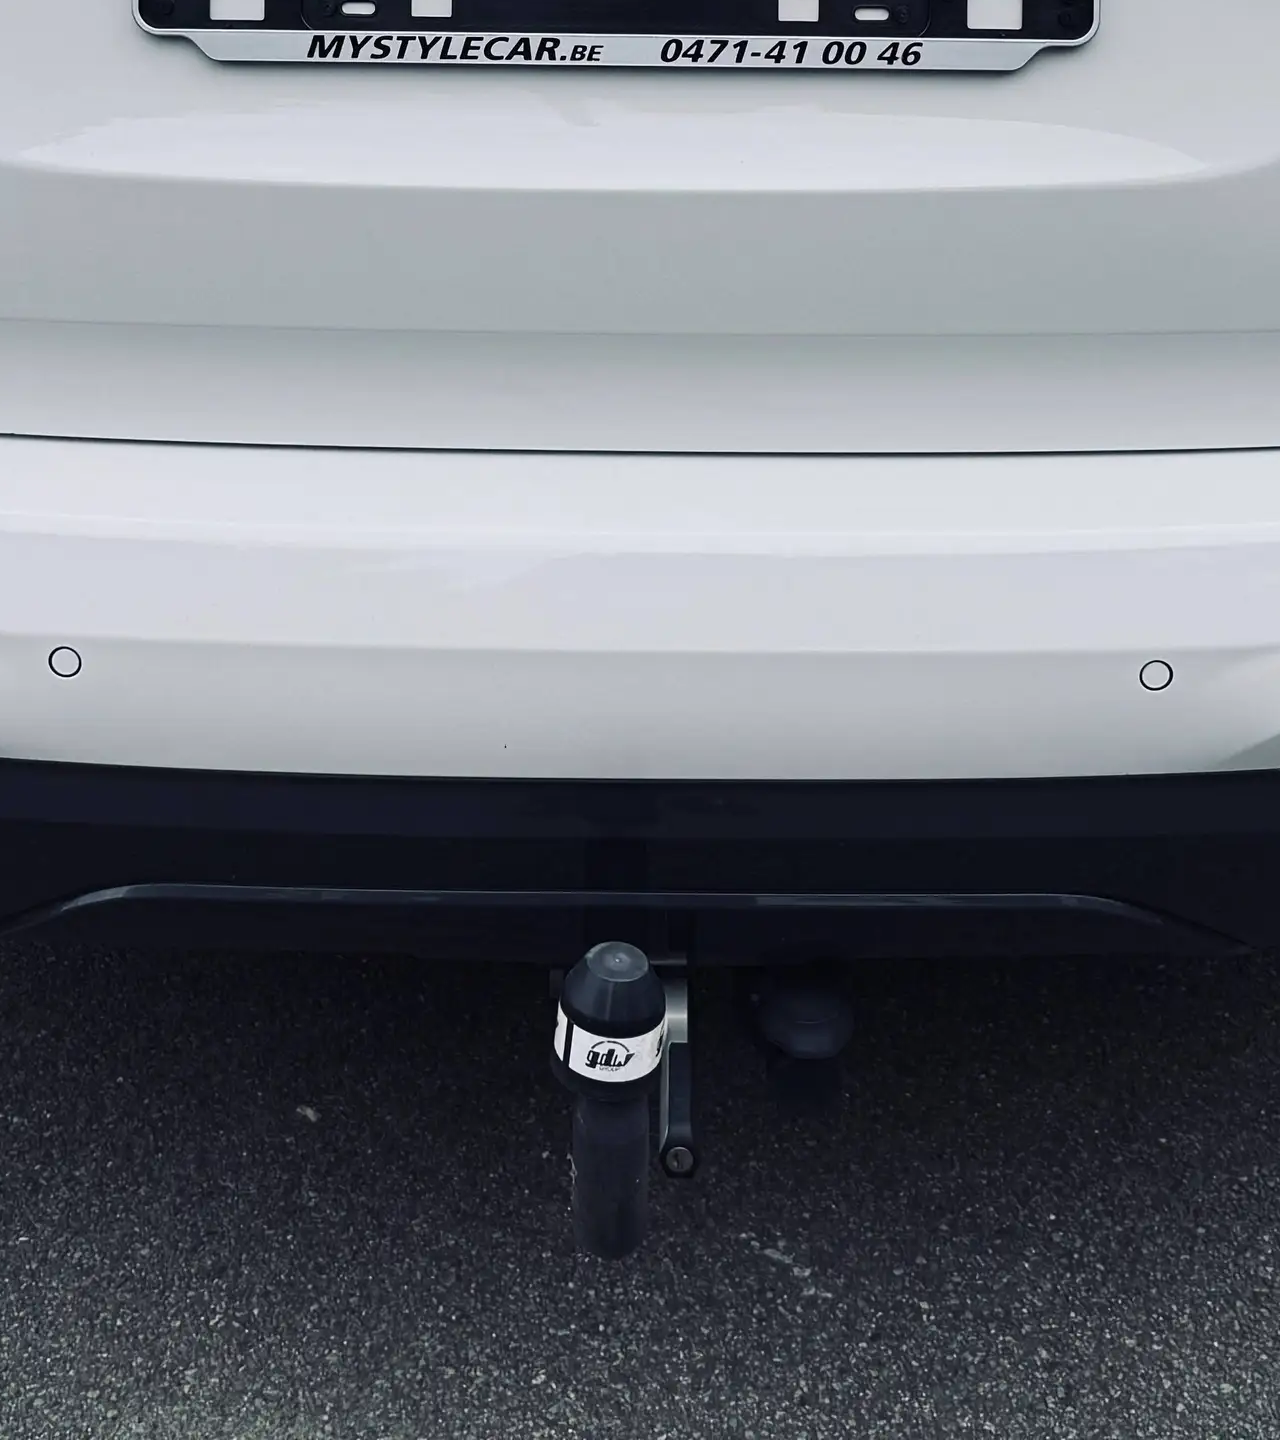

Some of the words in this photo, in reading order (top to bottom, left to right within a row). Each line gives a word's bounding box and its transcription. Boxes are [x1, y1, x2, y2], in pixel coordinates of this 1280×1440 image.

[306, 34, 604, 62] MYSTYLECAR.BE
[660, 38, 809, 64] 0471-41
[821, 40, 868, 65] 00
[876, 41, 924, 66] 46
